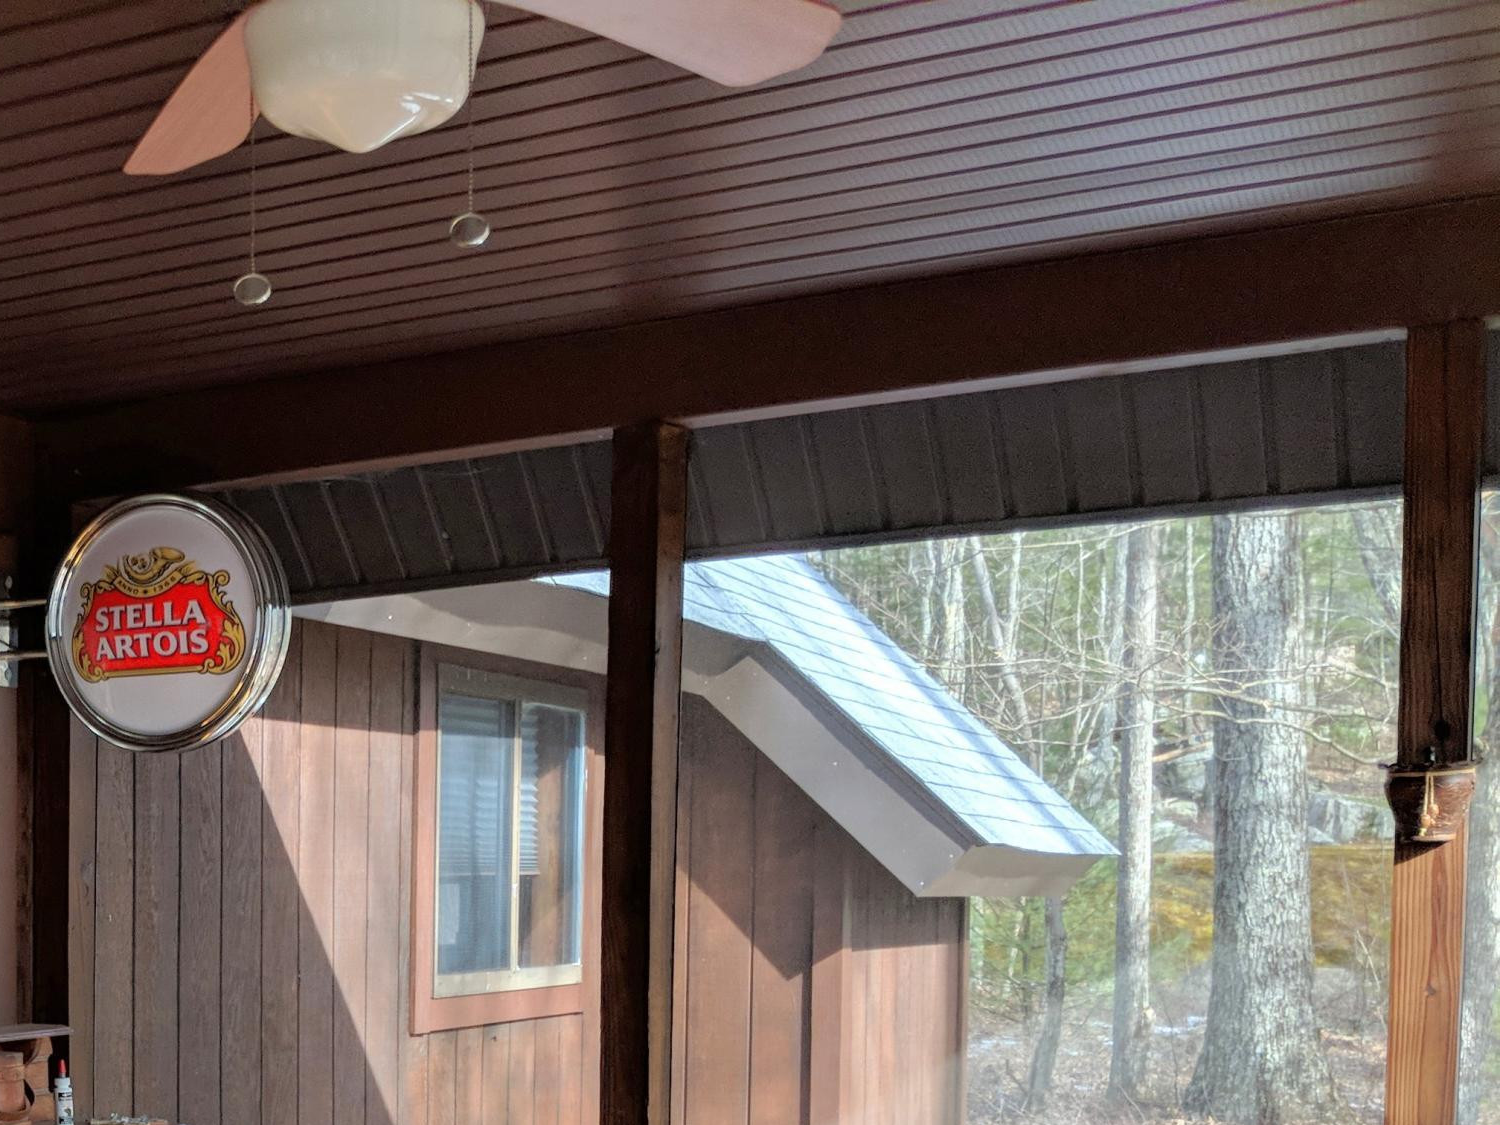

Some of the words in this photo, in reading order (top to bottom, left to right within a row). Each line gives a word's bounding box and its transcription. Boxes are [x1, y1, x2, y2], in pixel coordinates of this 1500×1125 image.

[117, 579, 140, 595] ANNO
[95, 599, 206, 632] STELLA
[96, 629, 209, 661] ARTOIS
